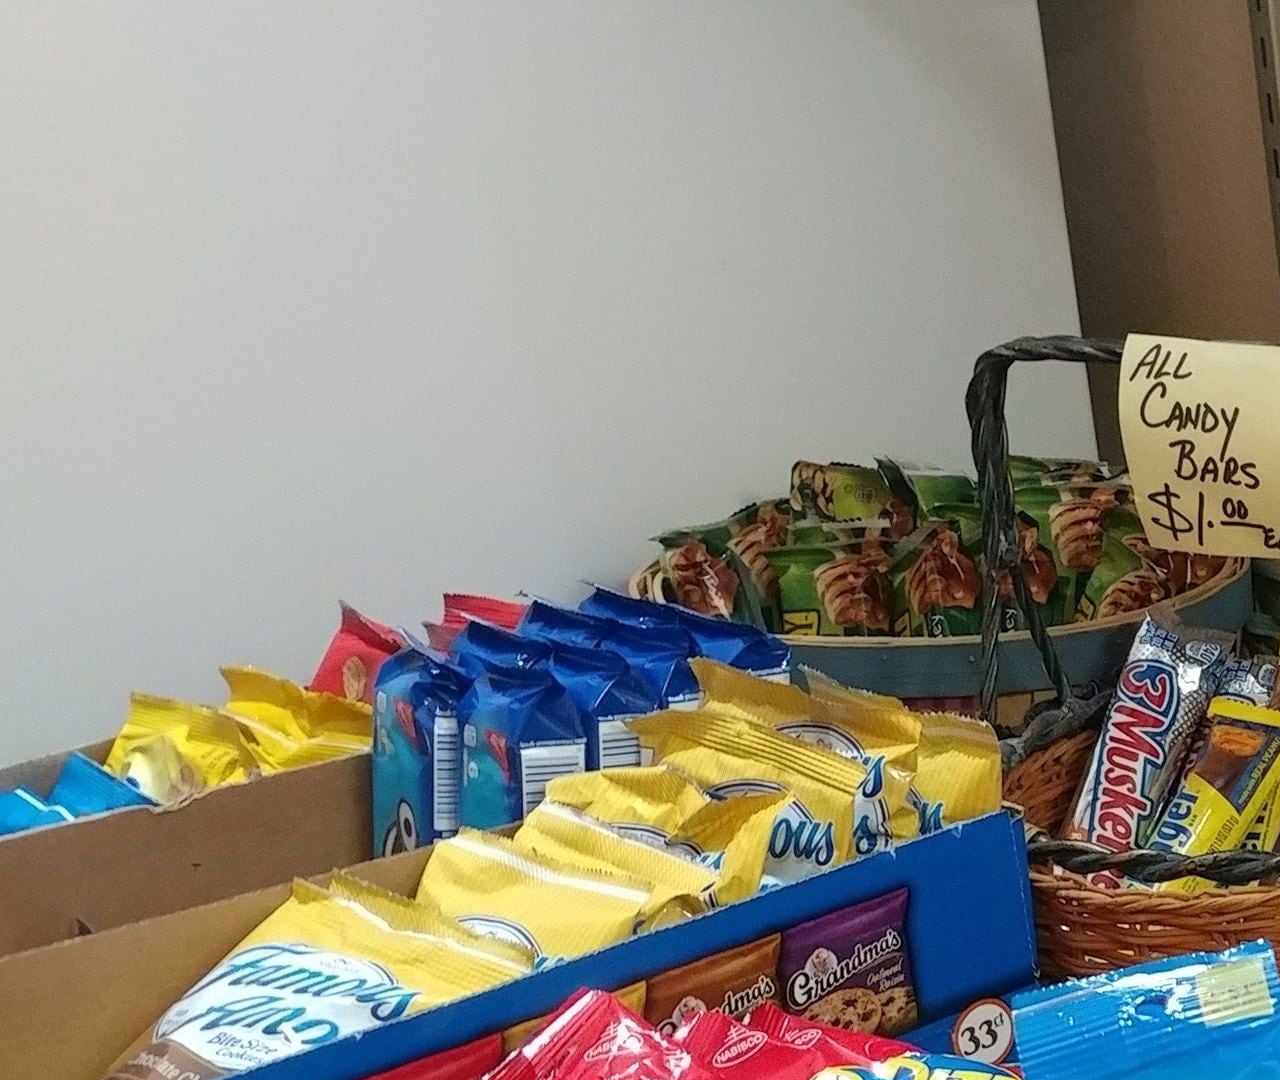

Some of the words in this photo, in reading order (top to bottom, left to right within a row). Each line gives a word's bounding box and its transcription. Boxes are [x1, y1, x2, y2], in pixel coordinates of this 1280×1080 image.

[1129, 342, 1194, 381] ALL
[1138, 380, 1241, 463] CANDY
[1168, 438, 1261, 490] BARS
[1119, 662, 1170, 714] 3
[180, 945, 422, 1022] Famous
[786, 927, 901, 1011] Grandma's
[715, 1033, 766, 1065] NABISCO
